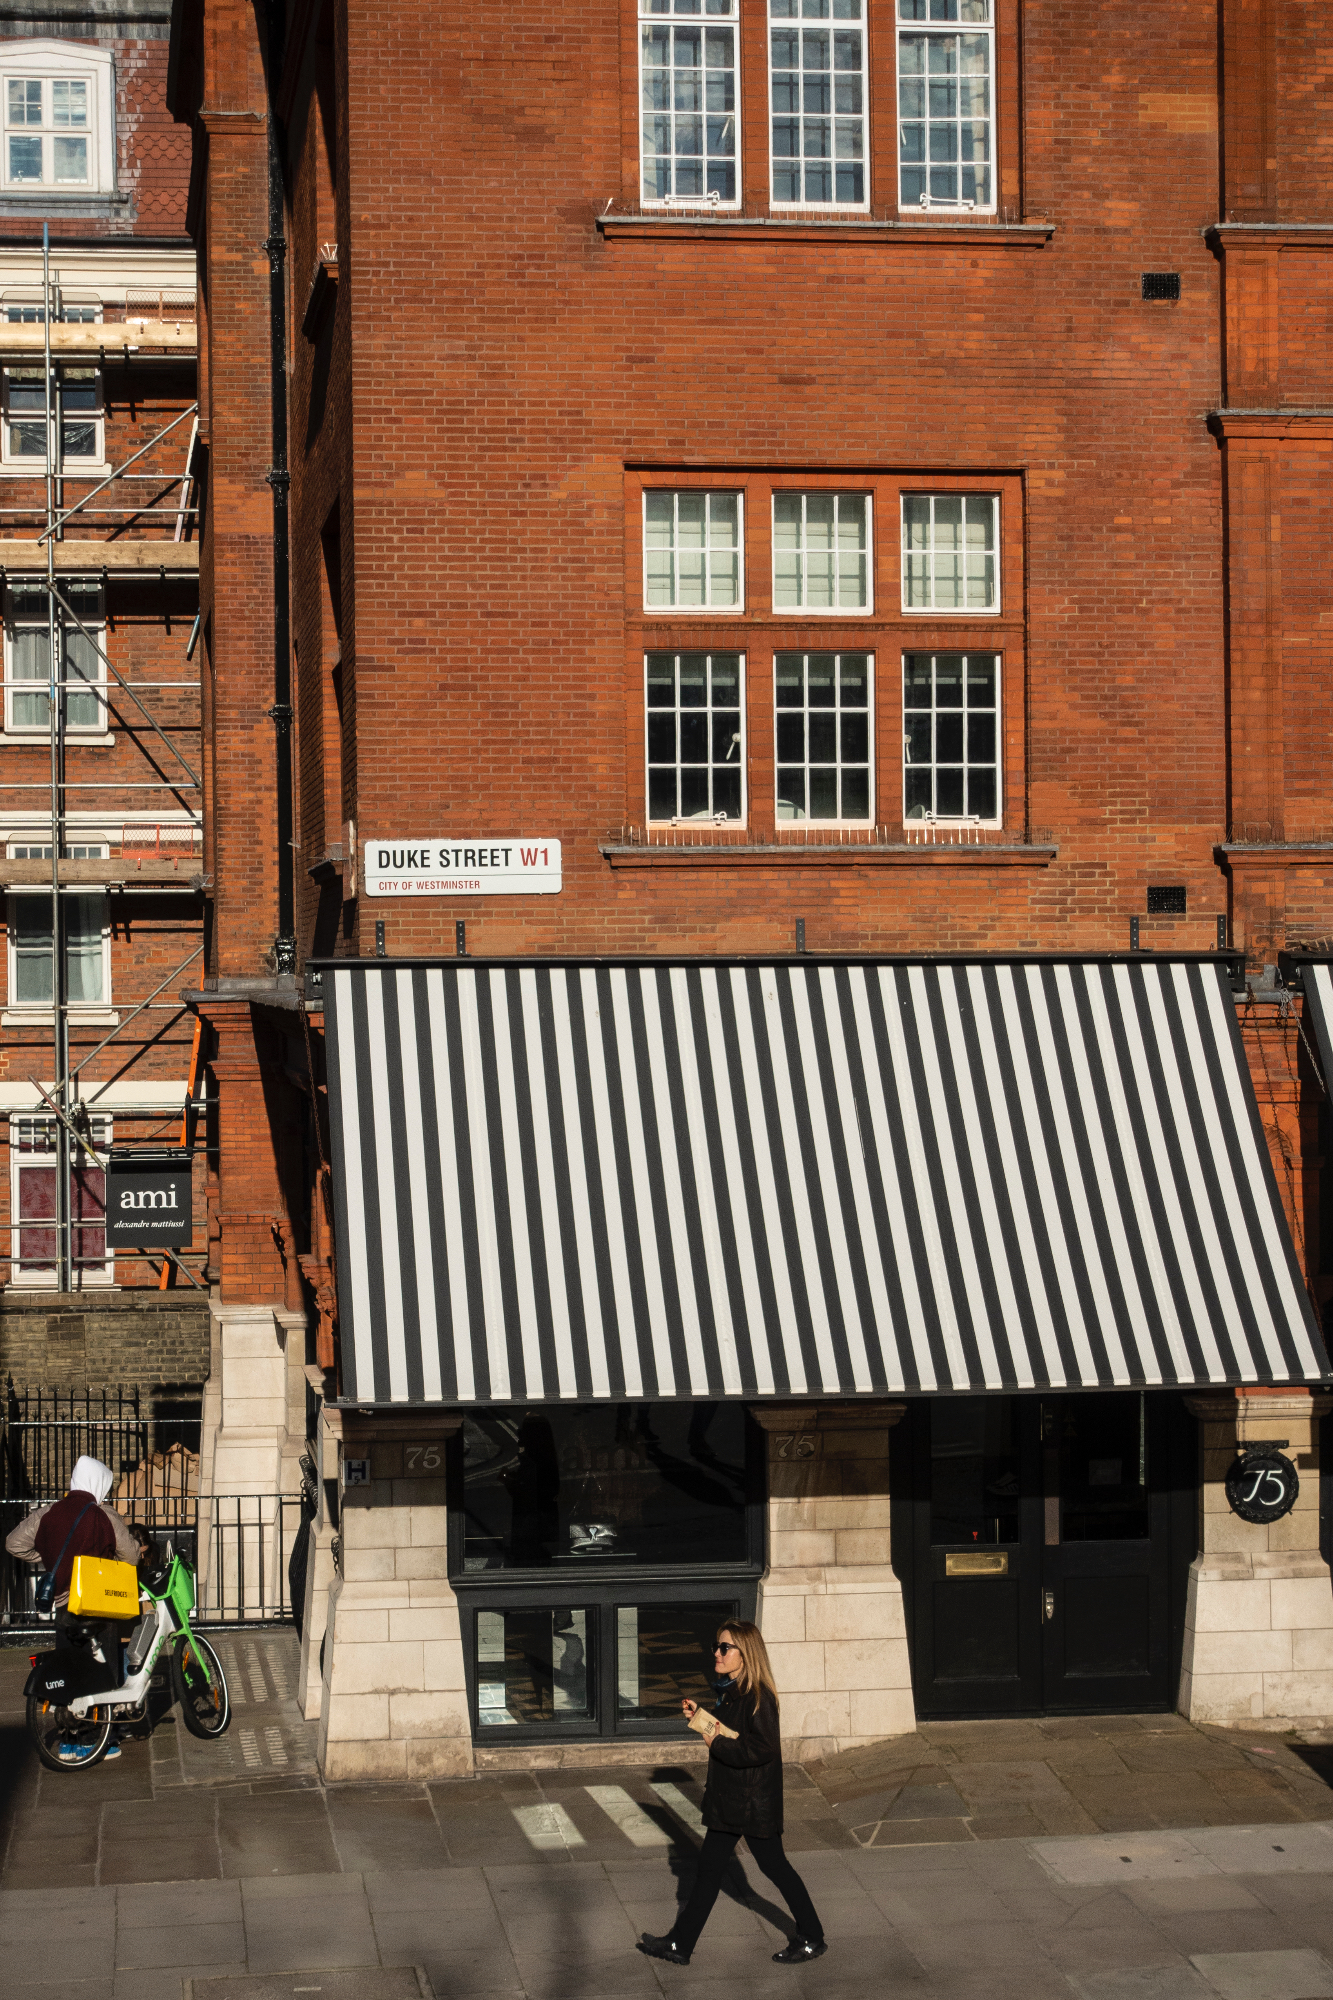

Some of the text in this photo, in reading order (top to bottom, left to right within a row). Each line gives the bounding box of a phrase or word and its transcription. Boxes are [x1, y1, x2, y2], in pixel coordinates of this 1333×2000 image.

[378, 847, 549, 869] DUKE STREET W1
[378, 880, 481, 891] CITY OF WESTMINSTER
[120, 1183, 179, 1209] ami
[113, 1220, 185, 1229] alexandre mattiussi
[774, 1435, 816, 1458] 75
[406, 1446, 441, 1470] 75
[347, 1460, 367, 1480] H
[1242, 1469, 1285, 1506] 75
[45, 1679, 65, 1690] Lime
